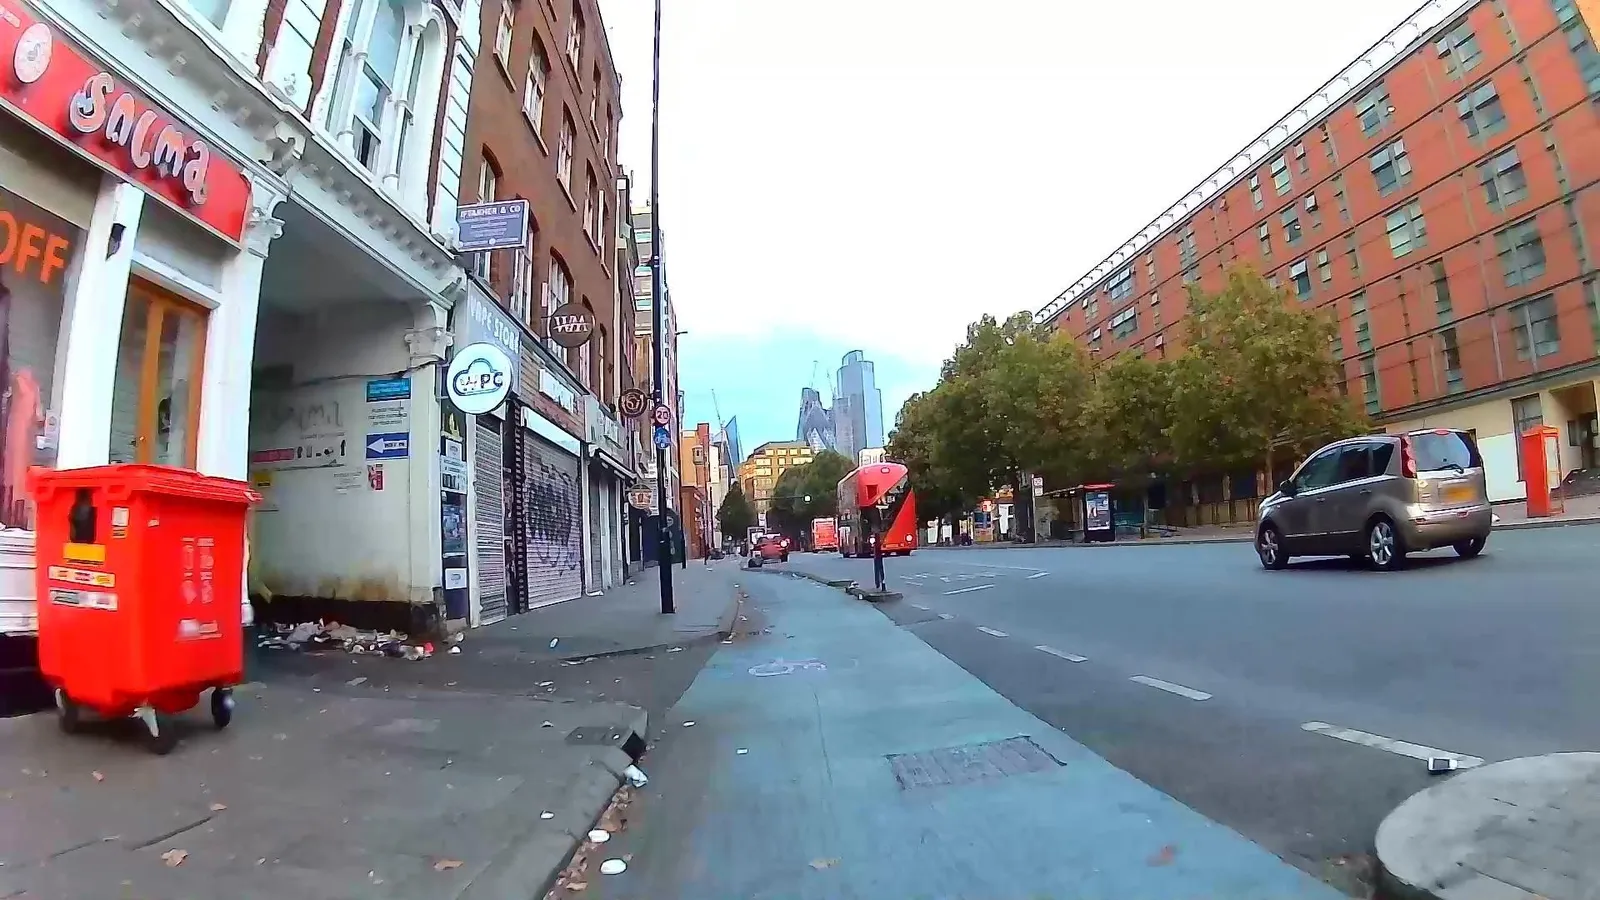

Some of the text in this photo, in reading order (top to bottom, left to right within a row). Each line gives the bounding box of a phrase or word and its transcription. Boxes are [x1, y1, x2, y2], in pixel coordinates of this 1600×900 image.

[500, 201, 507, 214] &
[509, 200, 521, 213] CO
[0, 210, 69, 284] OFF
[470, 294, 519, 355] VAPE STORE
[657, 409, 669, 420] 20
